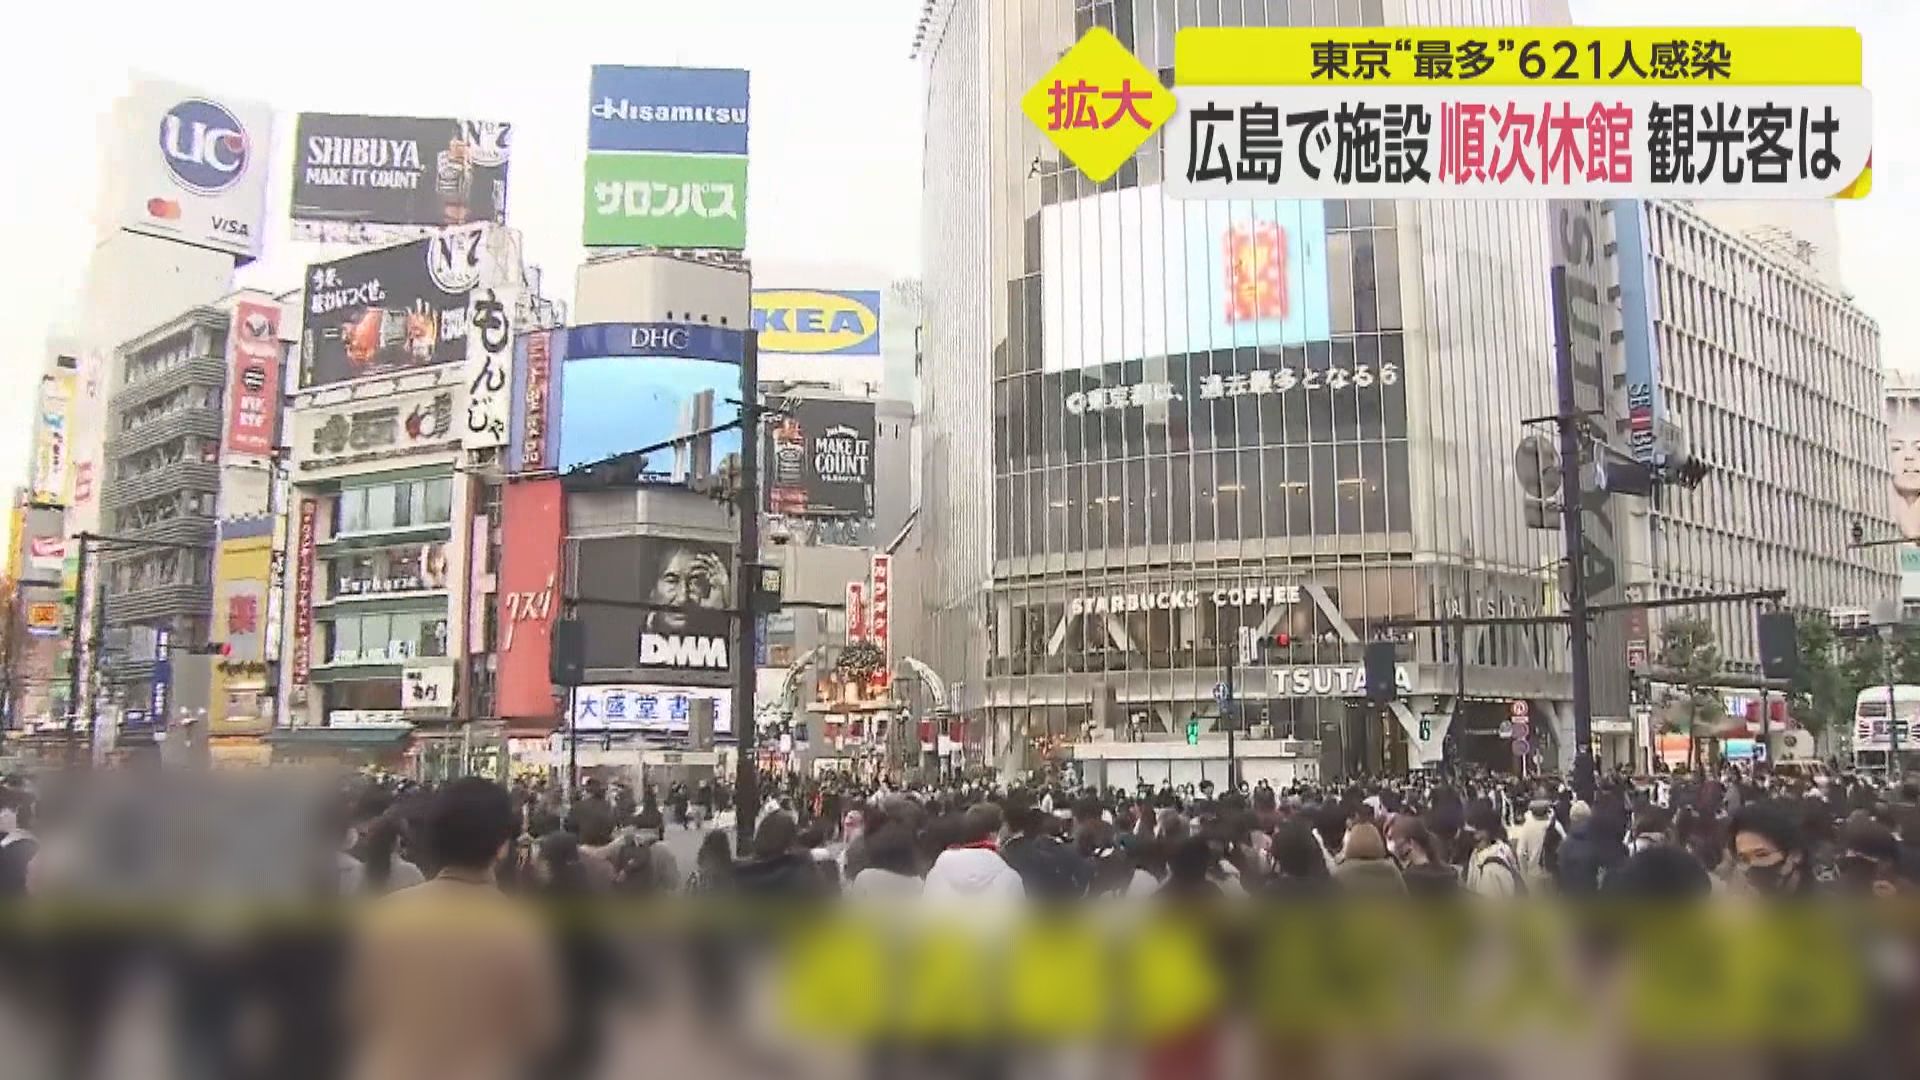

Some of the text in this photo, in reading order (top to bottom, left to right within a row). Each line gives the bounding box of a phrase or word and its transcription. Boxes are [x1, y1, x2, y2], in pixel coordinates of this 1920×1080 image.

[592, 97, 746, 124] Hisamitsu
[306, 168, 421, 189] MAKE IT COUNT
[594, 180, 737, 219] サロンパス
[211, 216, 250, 236] VISA
[752, 308, 865, 335] KEA
[631, 328, 689, 349] DHC
[467, 289, 514, 441] もんじゃ
[815, 438, 870, 455] MAKE IT
[814, 454, 869, 475] COUNT
[1071, 586, 1301, 614] STARBUCKS COFFEE
[640, 633, 728, 667] DMM
[1272, 664, 1412, 693] TSUTAA
